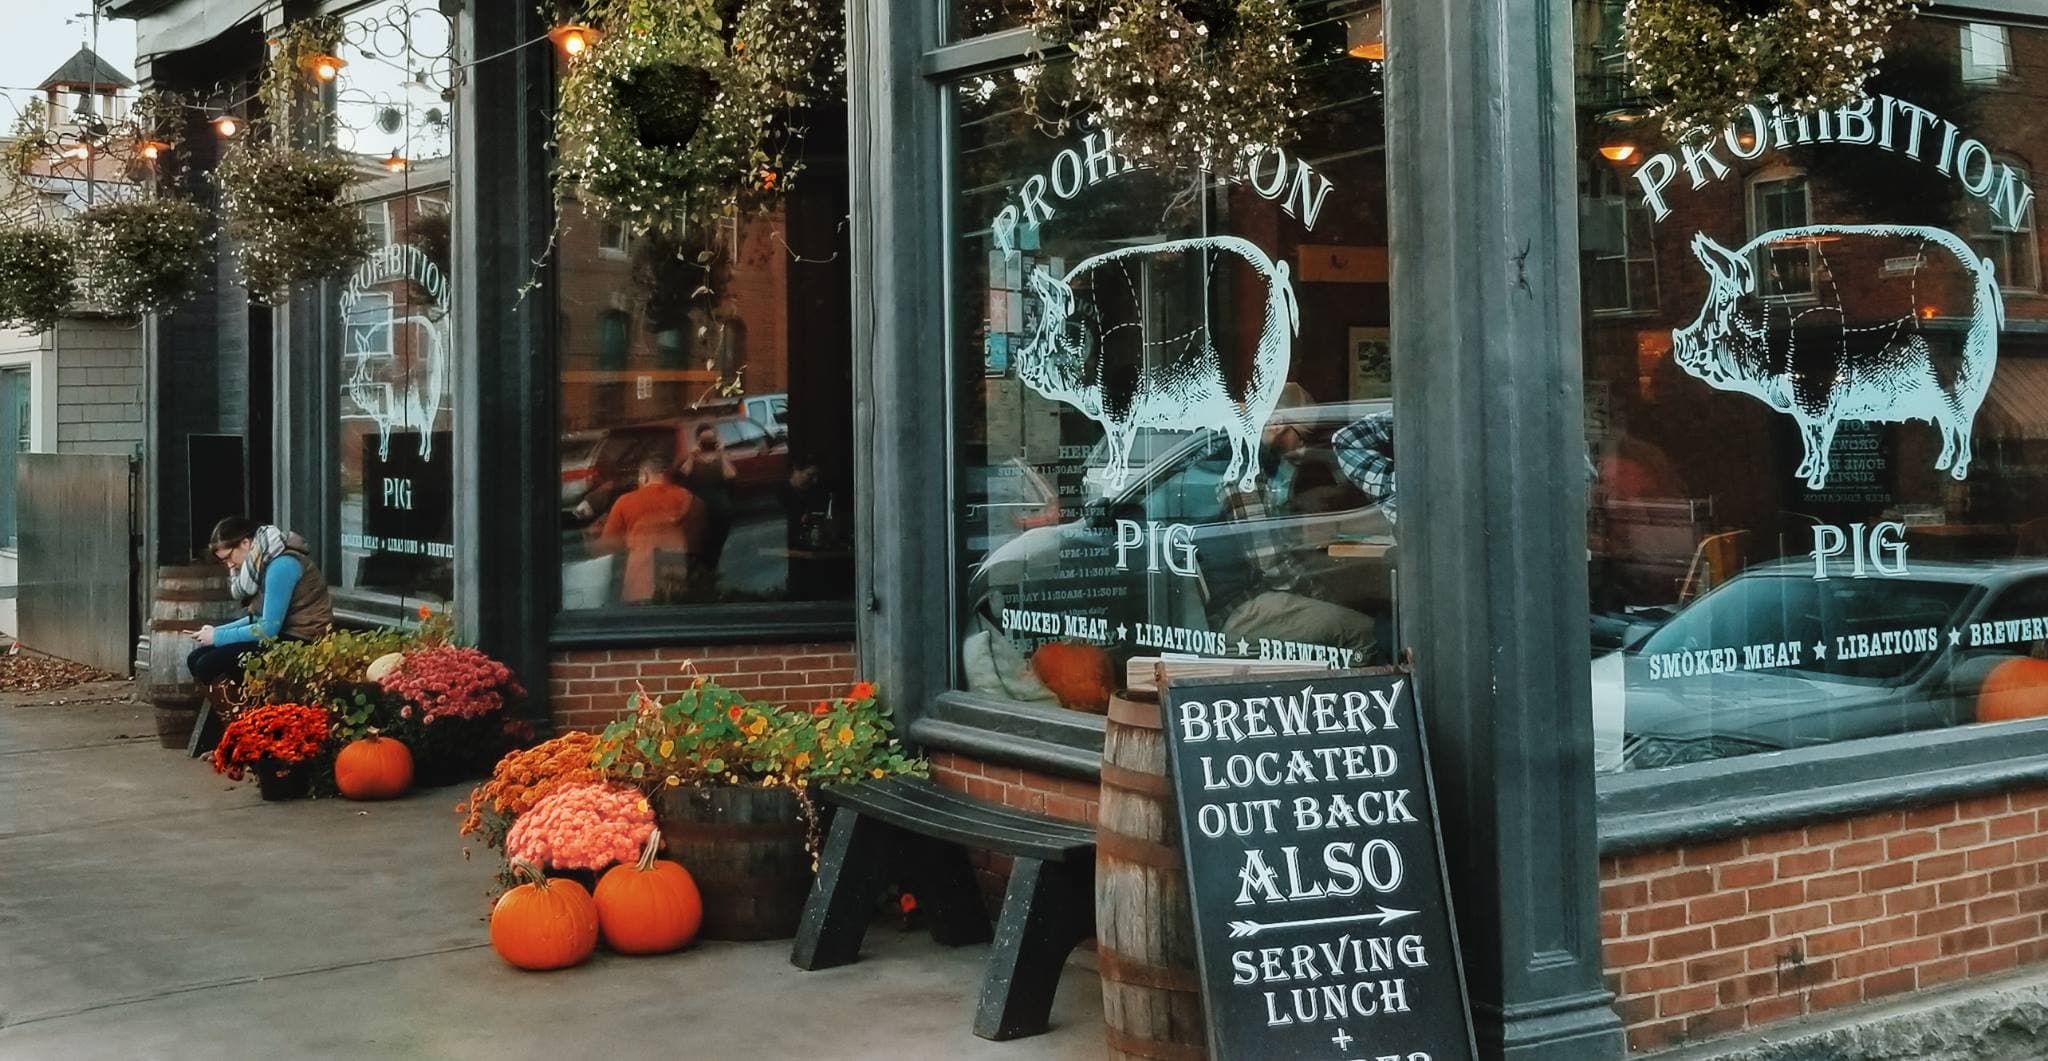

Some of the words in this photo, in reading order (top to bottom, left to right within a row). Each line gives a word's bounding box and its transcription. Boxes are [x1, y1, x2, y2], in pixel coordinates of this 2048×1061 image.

[1632, 94, 2035, 232] PROHIBITION
[992, 127, 1335, 260] PROHON
[383, 478, 412, 510] PIG
[1113, 519, 1198, 577] PIG
[1809, 522, 1911, 581] PIG
[1002, 608, 1060, 634] SMOKED
[1064, 615, 1108, 641] MEAT
[1135, 623, 1227, 656] LIBATIONS
[1649, 645, 1738, 681] SMOKED
[1743, 641, 1803, 671] MEAT
[1837, 628, 1939, 660] LIBATIONS
[1179, 679, 1406, 744] BREWERY
[1202, 744, 1399, 791] LOCATED
[1197, 799, 1282, 838] OUT
[1293, 788, 1420, 832] BACK
[1234, 839, 1404, 906] ALSO
[1232, 933, 1430, 986] SERVING
[1263, 978, 1412, 1028] LUNCH
